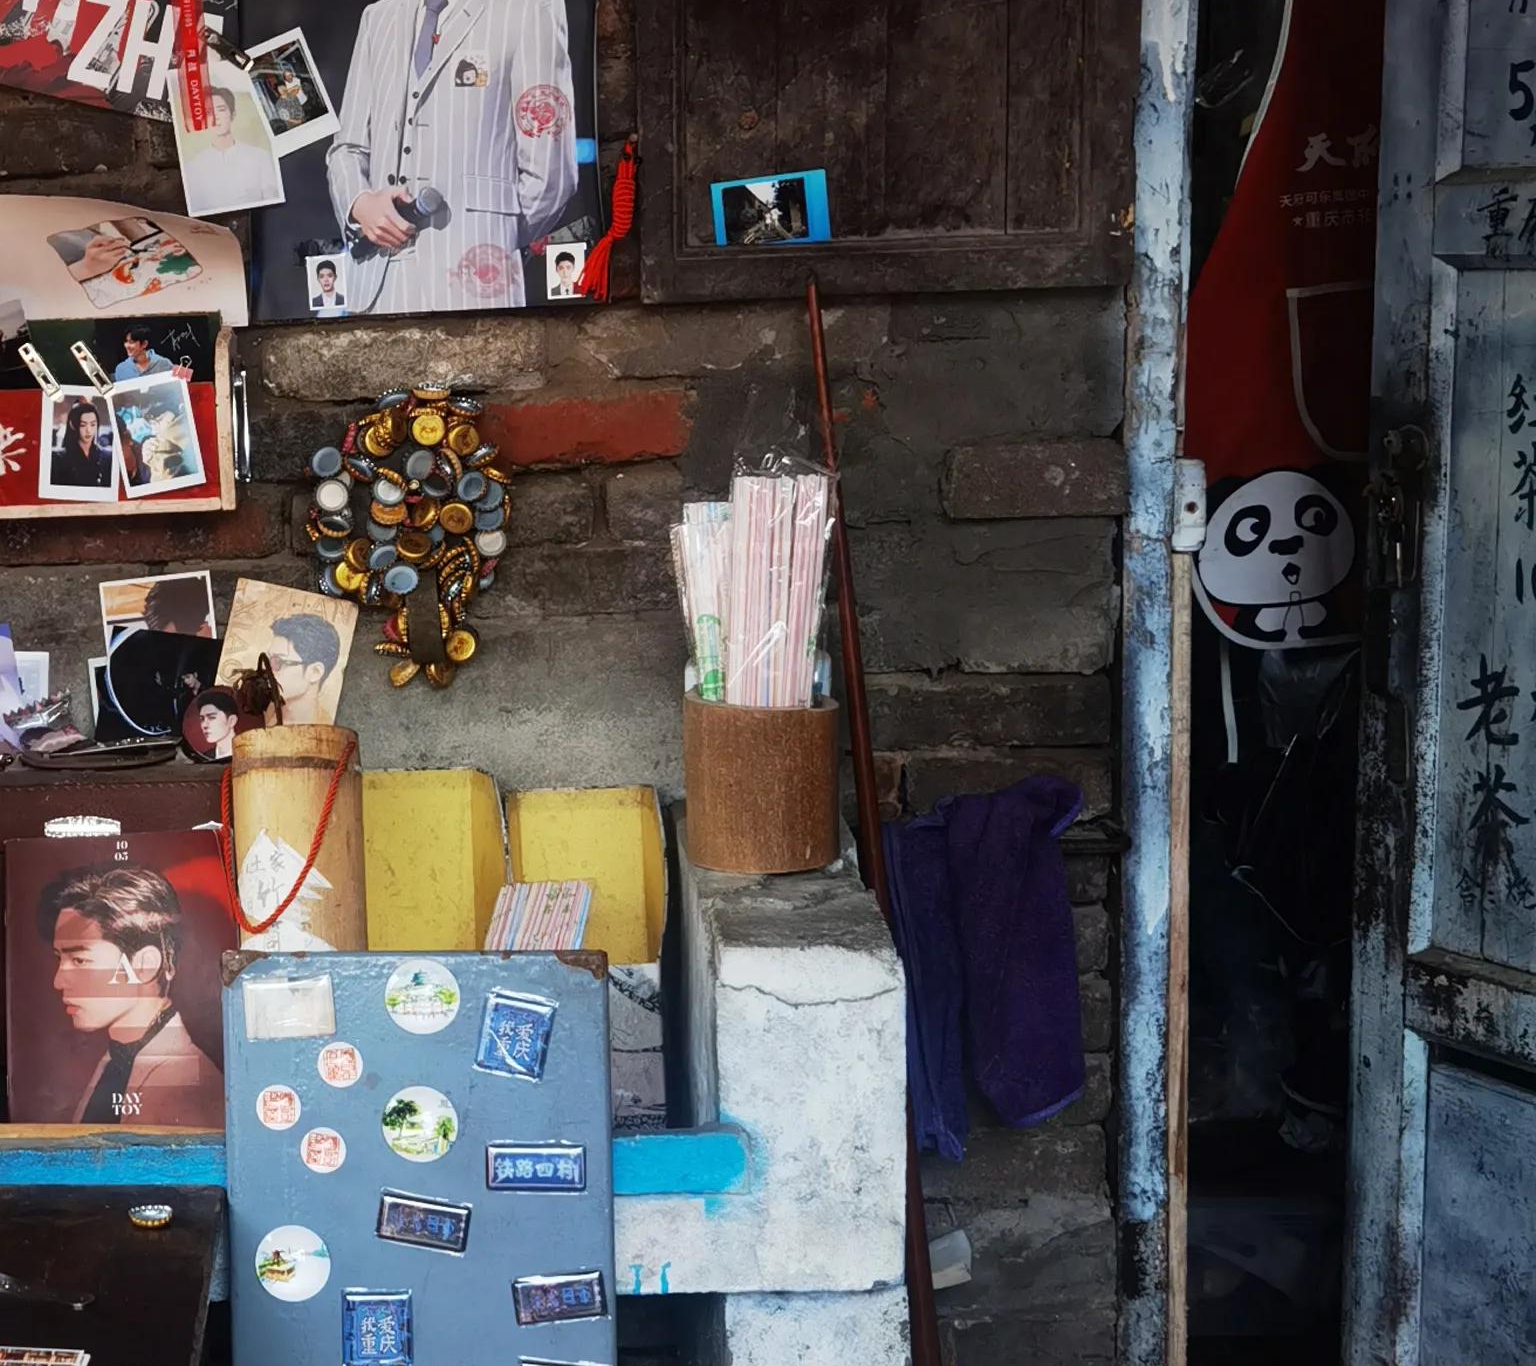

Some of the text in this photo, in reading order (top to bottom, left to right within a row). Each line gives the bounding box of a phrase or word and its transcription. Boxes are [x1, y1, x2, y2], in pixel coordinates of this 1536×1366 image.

[190, 79, 204, 122] DAYTOY
[116, 840, 128, 850] 10
[107, 952, 142, 985] A
[111, 1092, 143, 1104] DAY
[111, 1103, 143, 1116] TOY
